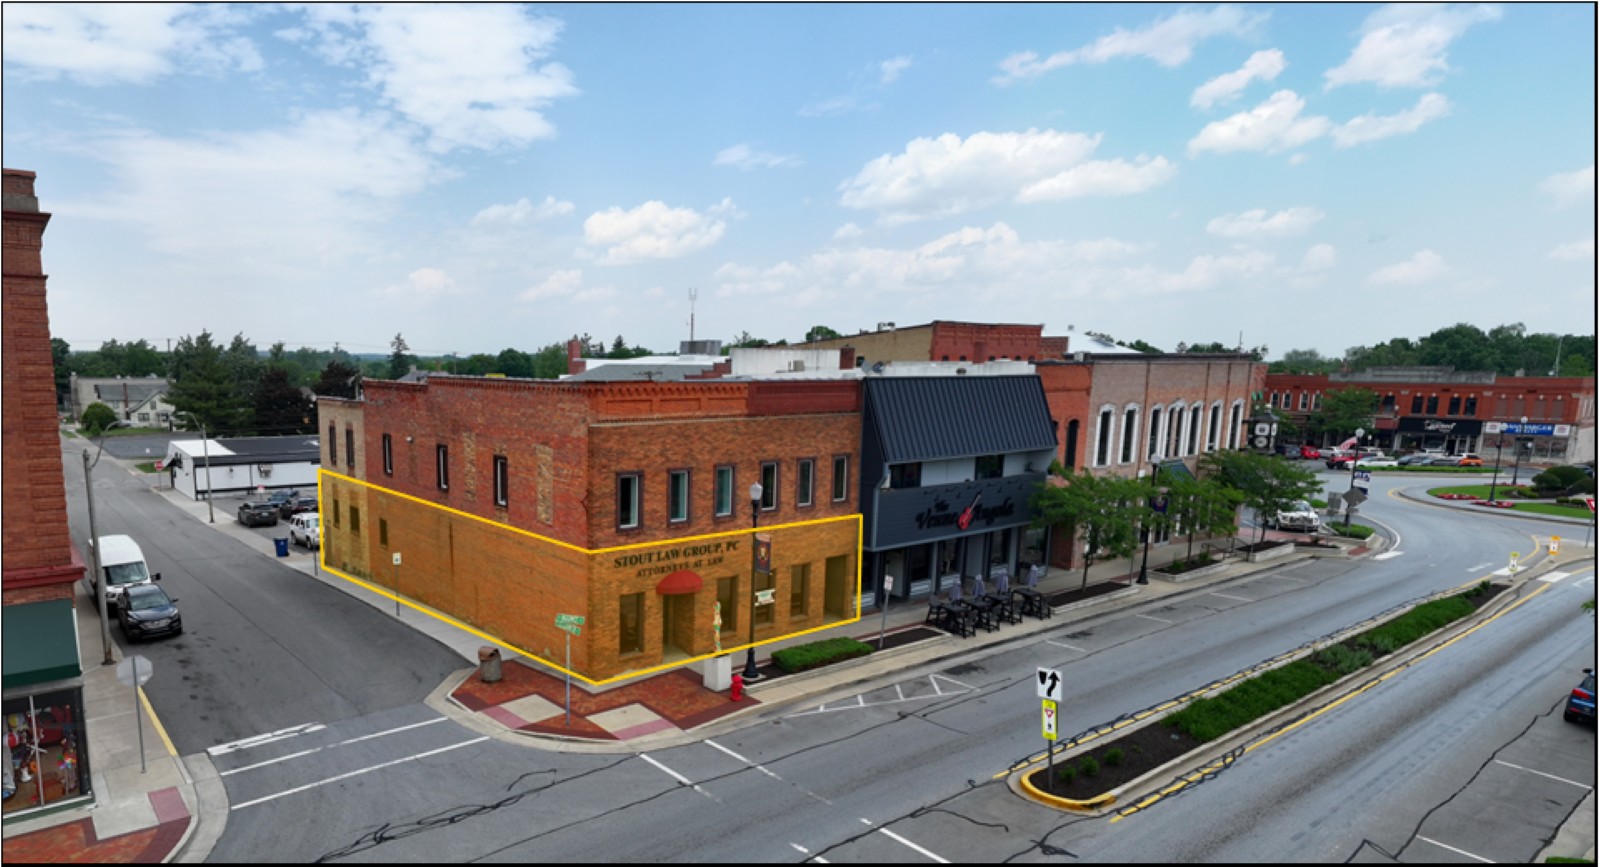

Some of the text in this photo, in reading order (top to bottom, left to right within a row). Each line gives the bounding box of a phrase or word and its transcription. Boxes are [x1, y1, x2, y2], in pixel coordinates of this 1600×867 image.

[614, 540, 740, 568] STOUT LAW GROUP, PC
[636, 556, 724, 577] ATTORNEYS AT LAW
